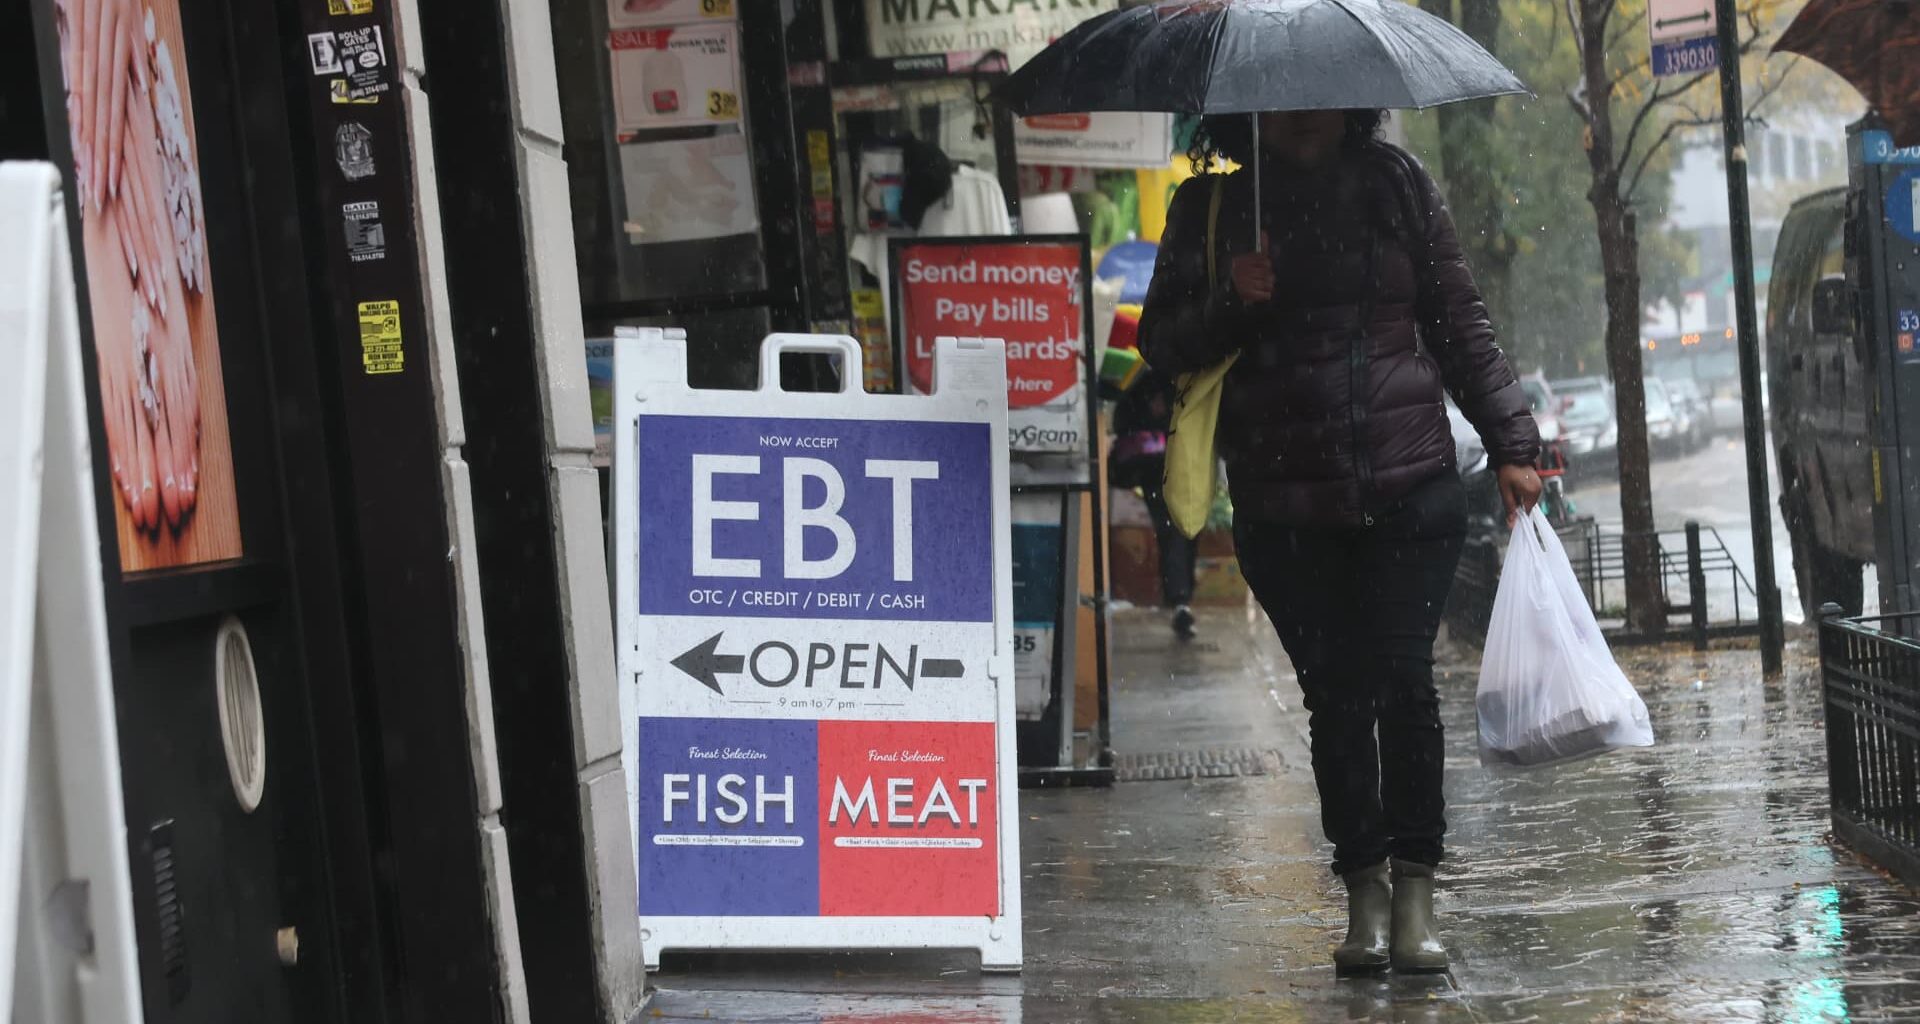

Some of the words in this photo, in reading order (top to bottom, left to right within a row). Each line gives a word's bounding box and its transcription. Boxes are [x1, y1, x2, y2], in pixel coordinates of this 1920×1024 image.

[614, 28, 659, 48] SALE
[907, 260, 977, 283] Send
[984, 266, 1079, 289] money
[936, 299, 987, 326] Pay
[993, 299, 1049, 322] bills
[1008, 336, 1070, 360] ards
[1015, 377, 1053, 391] here
[759, 436, 792, 447] NOW
[796, 437, 839, 449] ACCEPT
[1009, 425, 1077, 447] eyGram
[692, 453, 939, 582] EBT
[689, 590, 723, 605] OTC
[742, 591, 798, 607] CREDIT
[817, 592, 861, 608] DEBIT
[880, 594, 925, 609] CASH
[750, 640, 918, 692] OPEN
[779, 697, 787, 707] 9
[791, 700, 808, 708] am
[811, 699, 823, 708] to
[826, 698, 835, 708] 7
[838, 701, 855, 711] pm
[689, 746, 720, 760] Finest
[721, 747, 768, 760] Selection
[868, 749, 898, 762] Finest
[900, 749, 945, 762] Selection
[662, 773, 794, 827] FISH
[828, 775, 987, 828] MEAT
